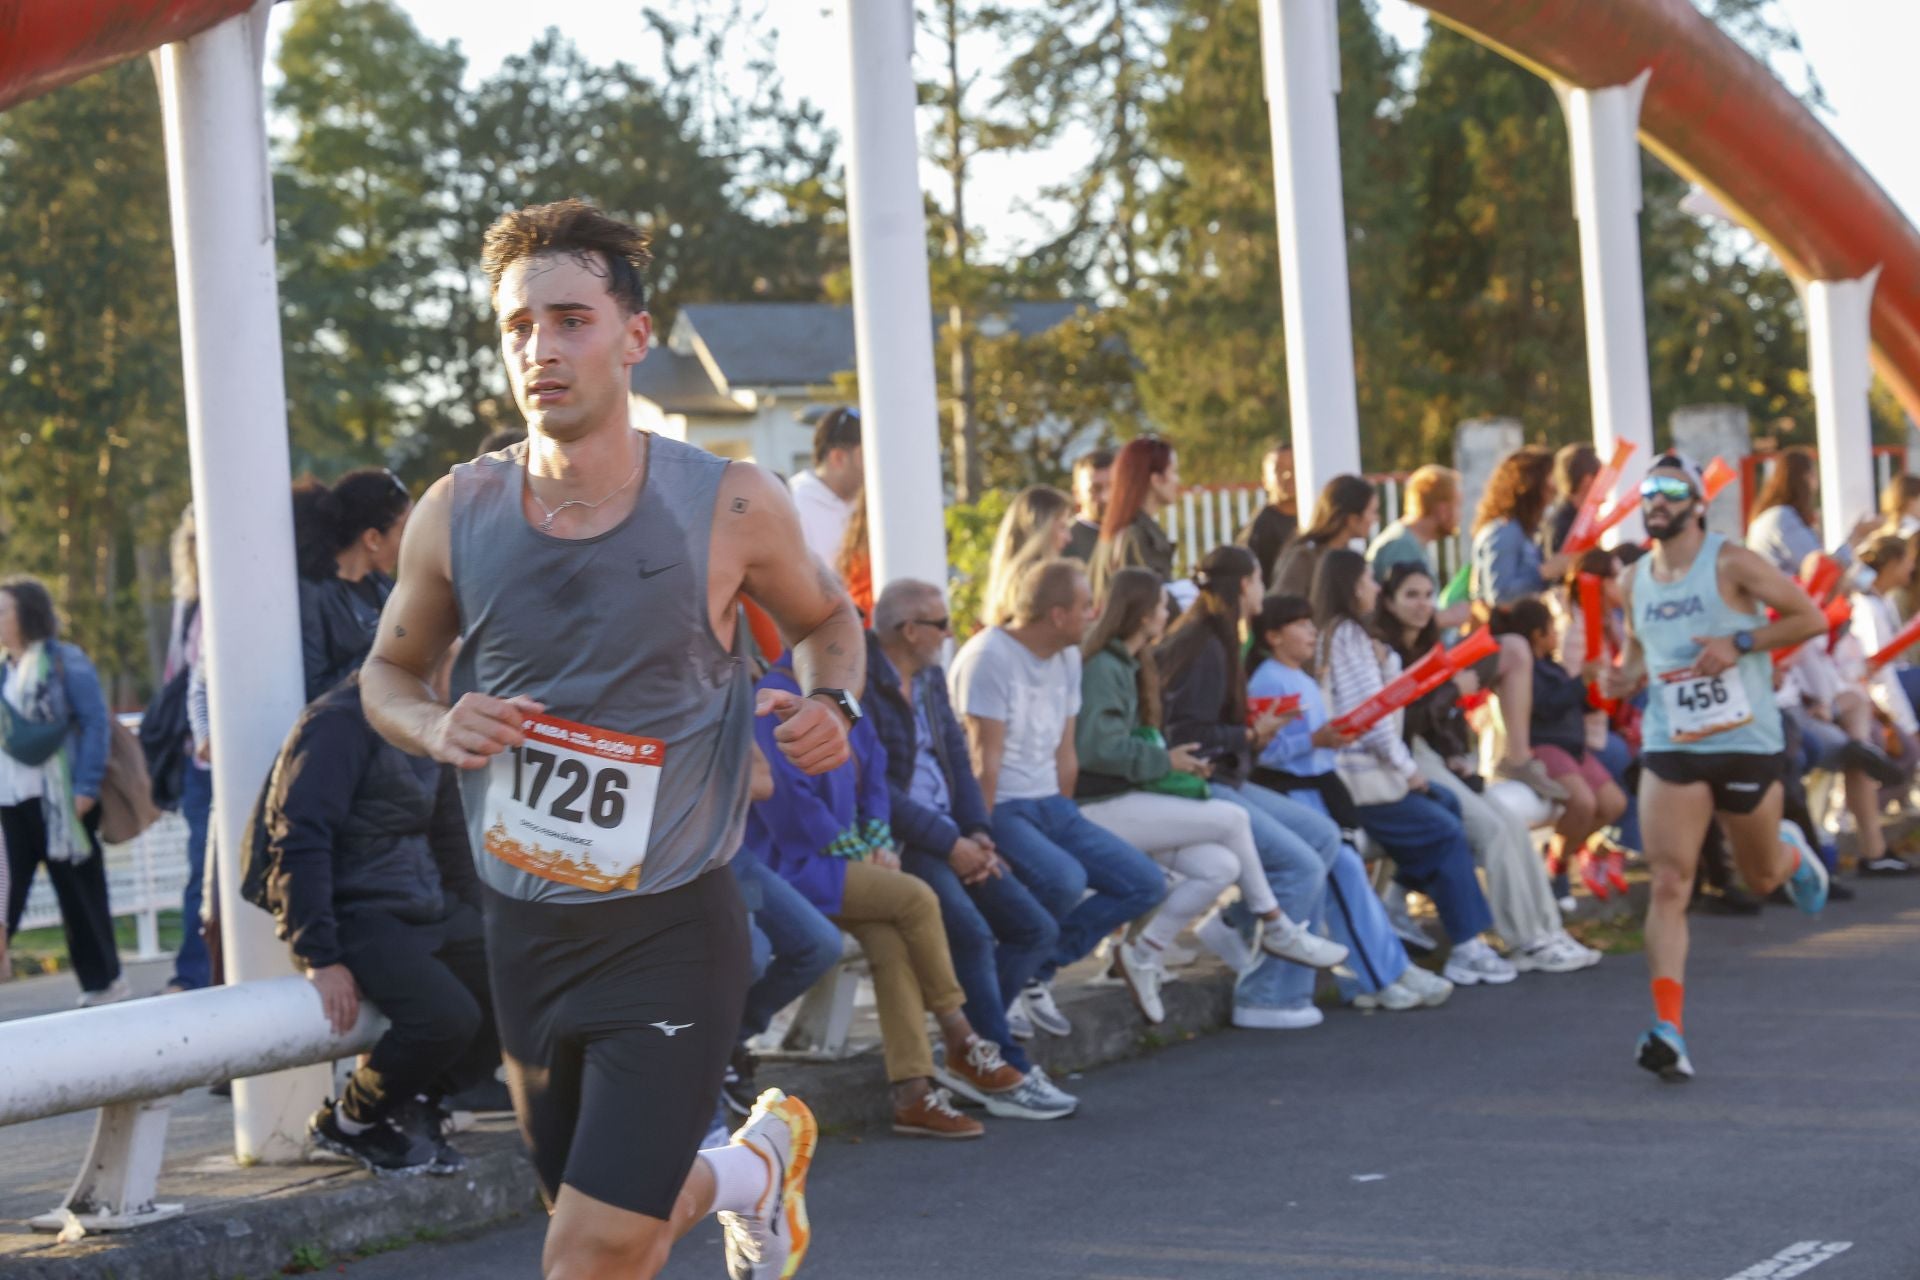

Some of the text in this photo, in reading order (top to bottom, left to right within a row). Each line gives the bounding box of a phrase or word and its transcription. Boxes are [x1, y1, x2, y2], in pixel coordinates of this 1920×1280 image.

[1645, 595, 1704, 622] HOKA
[1678, 678, 1728, 711] 456
[511, 746, 629, 829] 1726
